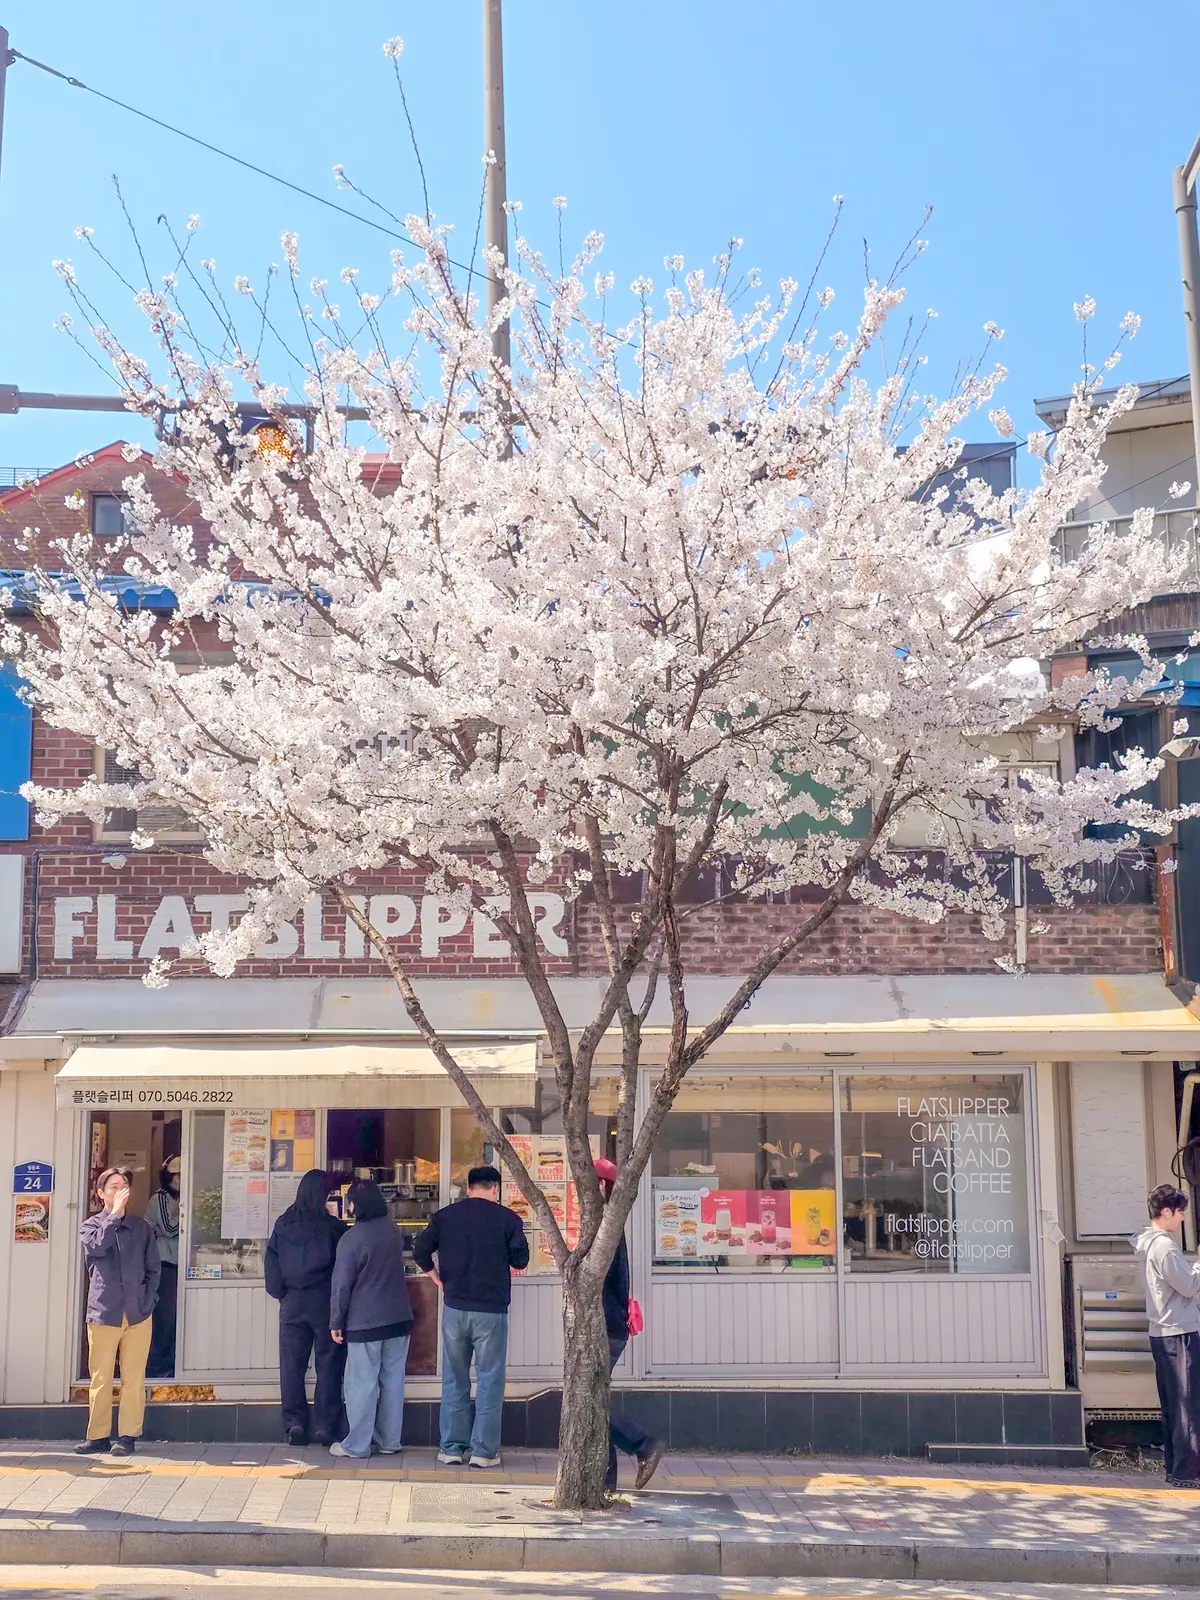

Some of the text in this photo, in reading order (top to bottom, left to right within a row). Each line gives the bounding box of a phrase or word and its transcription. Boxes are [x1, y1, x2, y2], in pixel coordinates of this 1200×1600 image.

[72, 1090, 233, 1103] 플랫슬리퍼 070.5046.2822
[897, 1097, 1010, 1118] FLATSLIPPER
[910, 1122, 1010, 1143] CIABATTA
[912, 1147, 1011, 1168] FLATSAND
[23, 1177, 42, 1190] 24
[933, 1172, 1011, 1194] COFFEE
[887, 1214, 1014, 1237] flatslipper.com
[914, 1239, 1014, 1262] @flatslipper
